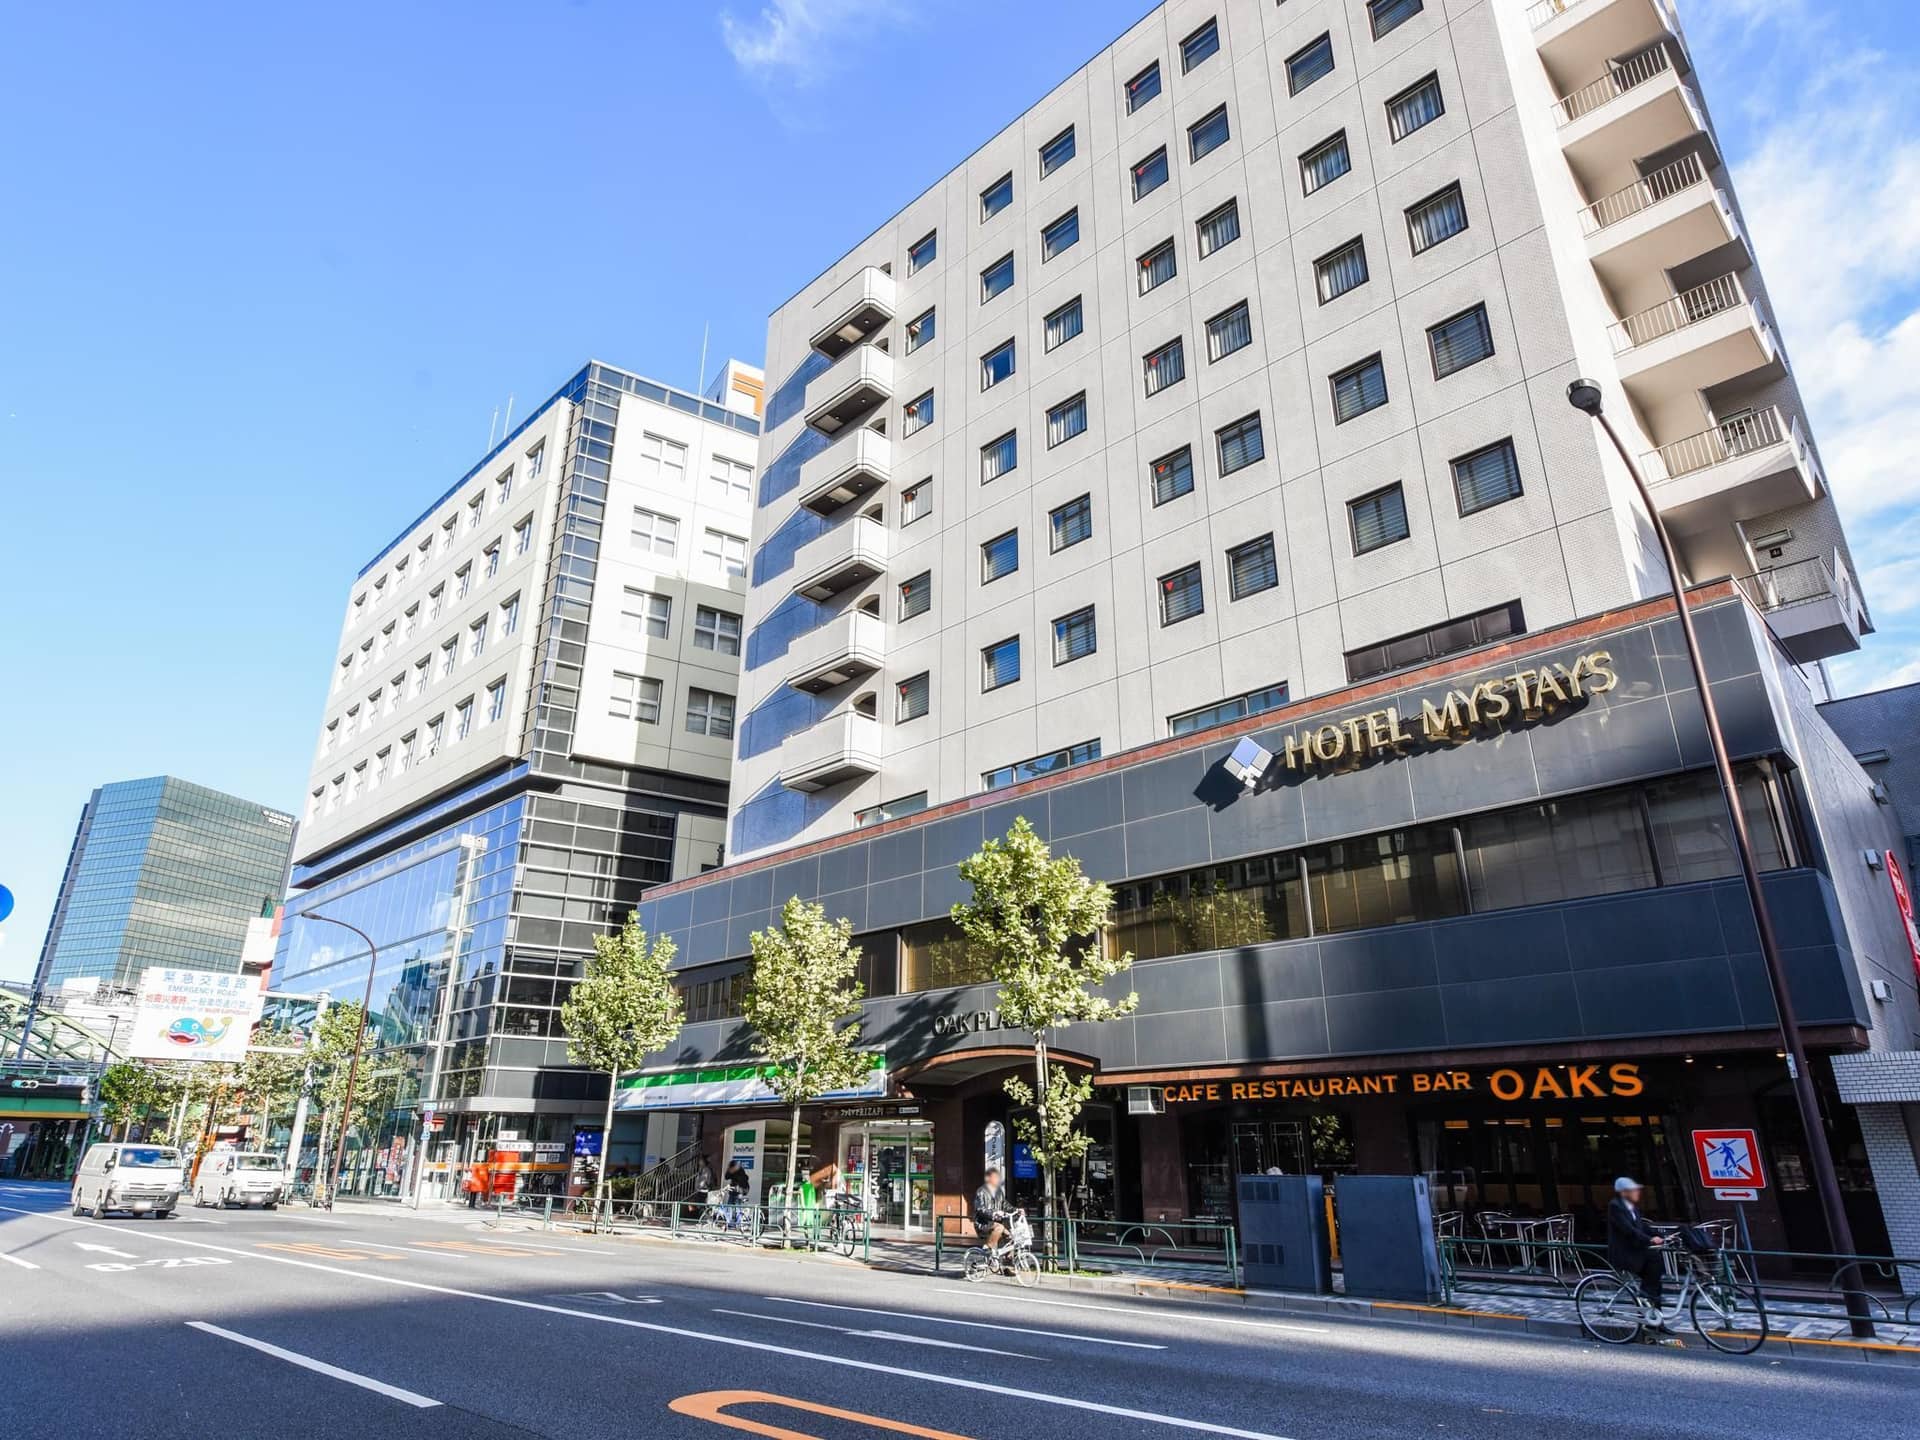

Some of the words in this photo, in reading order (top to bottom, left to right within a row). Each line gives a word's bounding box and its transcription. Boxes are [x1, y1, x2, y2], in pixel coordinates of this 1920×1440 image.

[1284, 707, 1412, 769] HOTEL
[1421, 650, 1618, 736] MYSTAYS
[167, 984, 214, 996] EMERGENCY
[934, 1013, 972, 1034] OAK
[1164, 1084, 1220, 1103] CAFE
[1231, 1074, 1398, 1100] RESTAURANT
[1412, 1071, 1472, 1093] BAR
[1490, 1063, 1644, 1101] OAKS
